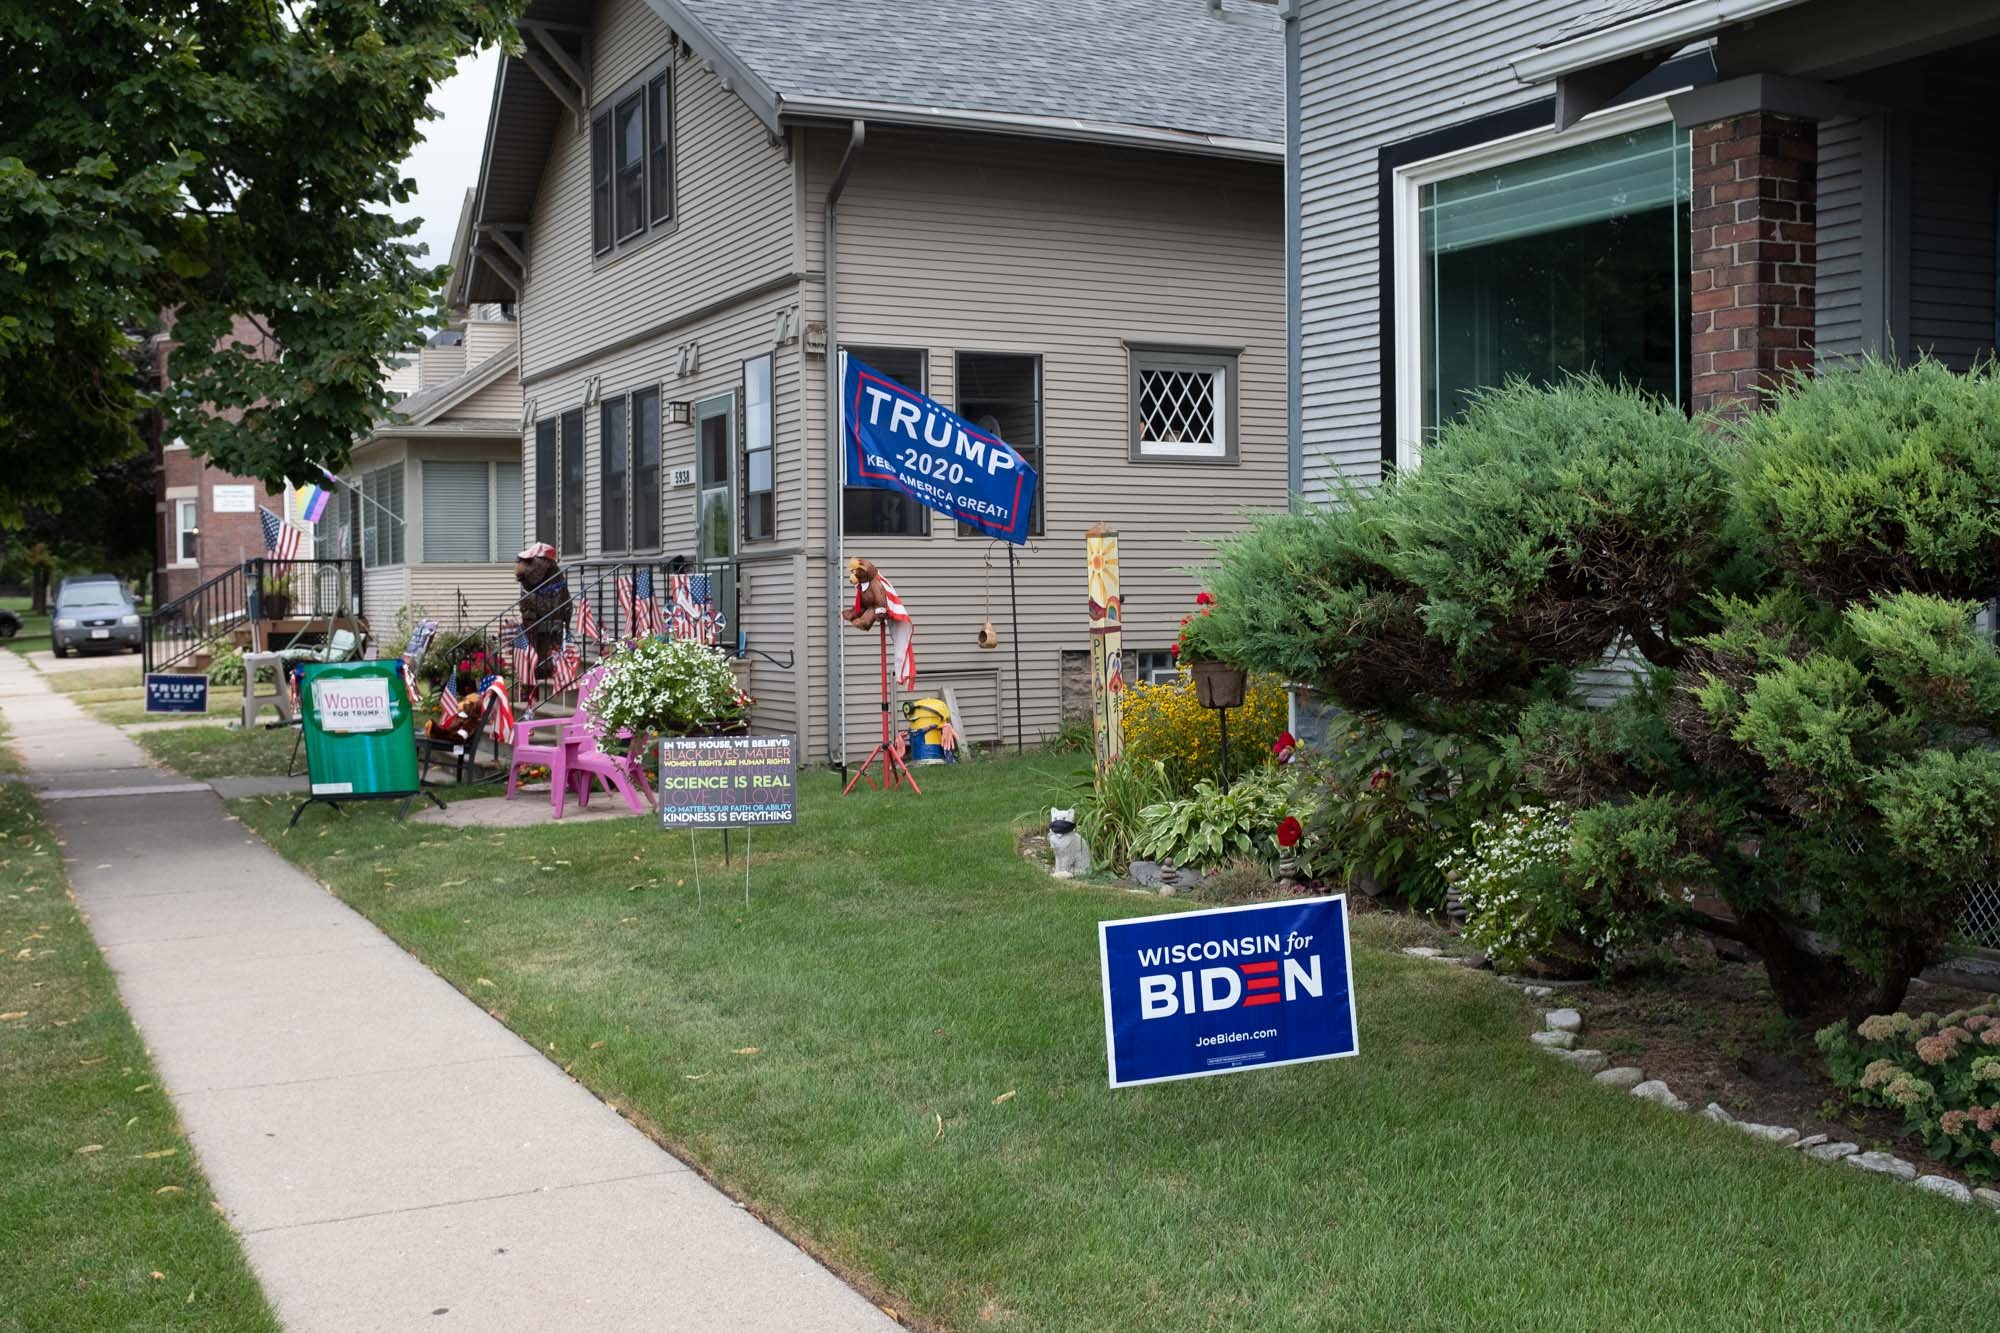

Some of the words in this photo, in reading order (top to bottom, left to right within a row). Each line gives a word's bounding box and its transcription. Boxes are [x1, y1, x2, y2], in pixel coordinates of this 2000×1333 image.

[866, 386, 1015, 475] TRUMP
[899, 473, 954, 503] AMERICA
[958, 496, 1008, 519] GREAT!
[150, 684, 204, 692] TRUMP
[324, 692, 384, 710] Women
[664, 742, 674, 750] IN
[676, 741, 696, 749] THIS
[700, 740, 732, 749] HOUSE,
[735, 740, 749, 748] WE
[664, 750, 703, 760] BLACK
[708, 749, 740, 760] LIVES
[745, 748, 791, 758] MATTER
[739, 758, 764, 766] HUMAN
[665, 776, 728, 790] SCIENCE
[735, 776, 748, 788] IS
[754, 774, 791, 787] REAL
[664, 790, 711, 806] LOVE
[720, 789, 736, 804] IS
[744, 788, 792, 804] LOVE
[664, 812, 716, 822] KINDNESS
[718, 812, 728, 822] IS
[730, 811, 792, 822] EVERYTHING
[752, 804, 764, 812] OR
[1138, 934, 1280, 967] WISCONSIN
[1284, 932, 1313, 956] for
[1140, 955, 1323, 1020] BIDEN
[1196, 1028, 1277, 1047] JoeBiden.com
